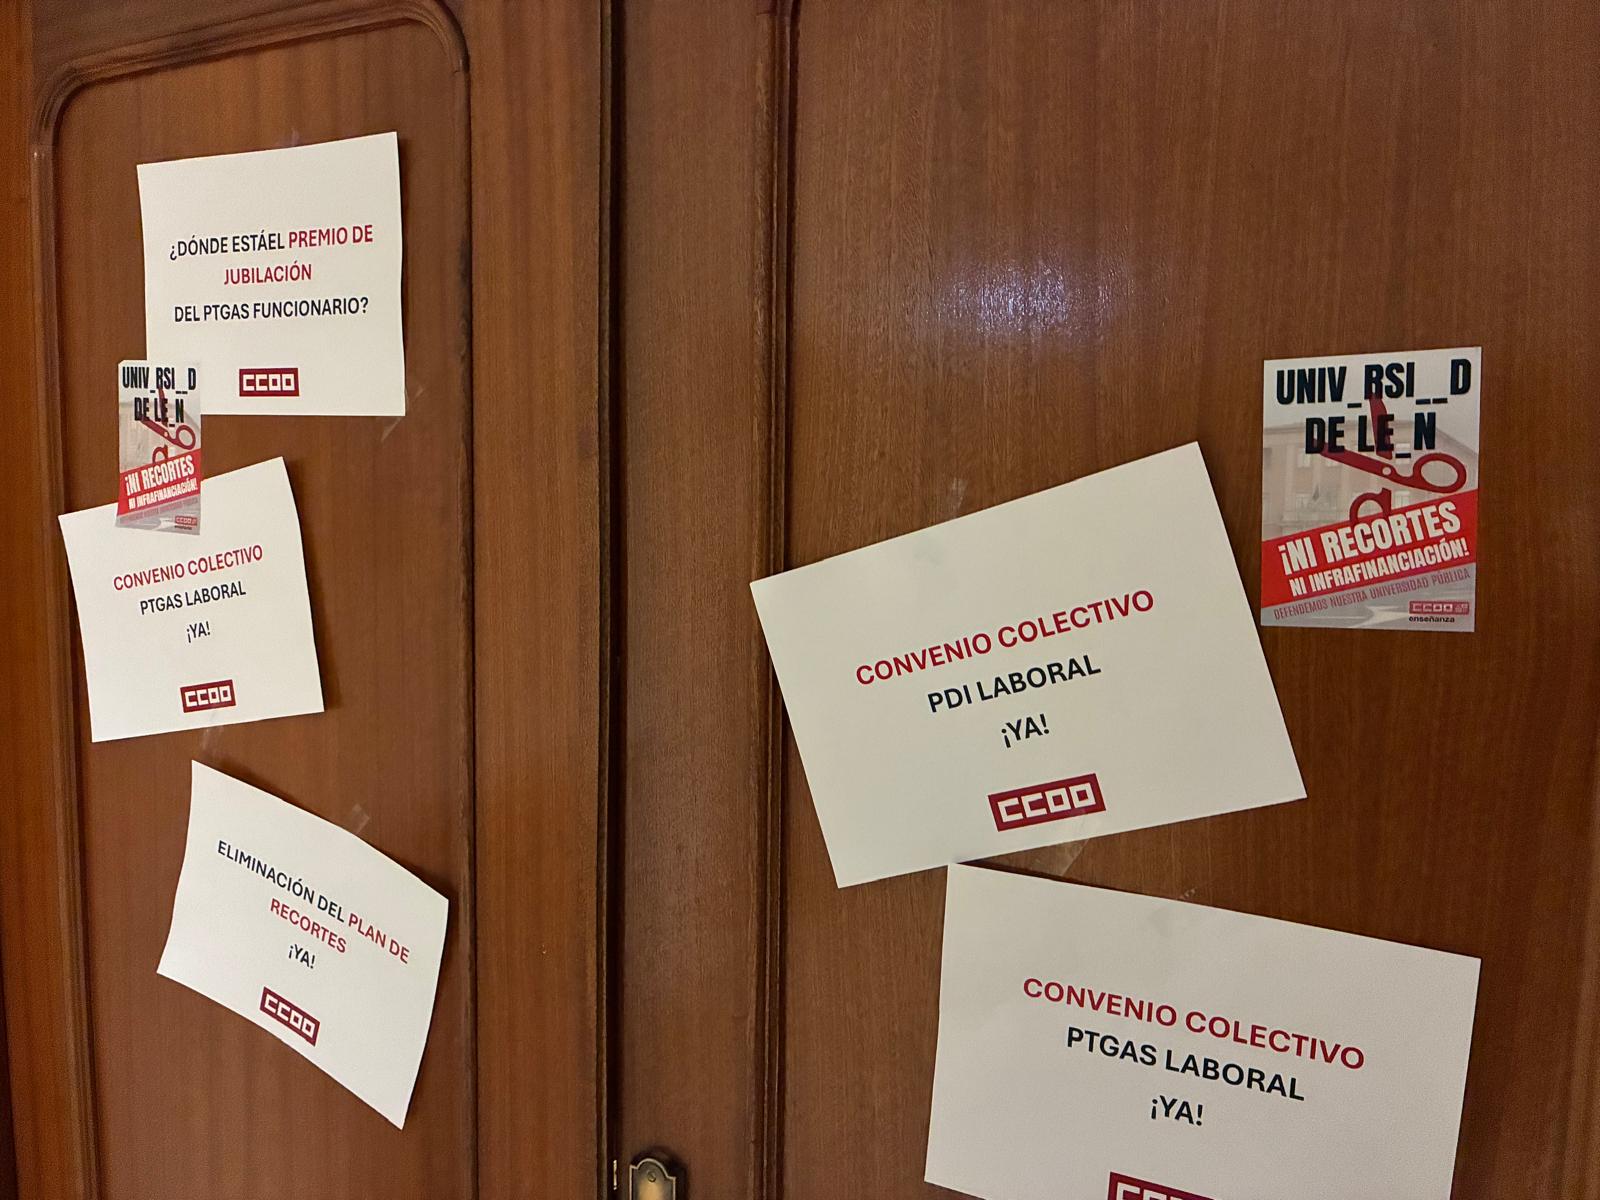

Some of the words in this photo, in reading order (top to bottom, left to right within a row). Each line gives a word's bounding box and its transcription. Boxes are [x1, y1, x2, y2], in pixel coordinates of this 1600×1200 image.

[170, 235, 228, 260] ¿DÓNDE
[288, 227, 348, 248] PREMIO
[352, 225, 373, 243] DE
[224, 261, 312, 285] JUBILACIÓN
[175, 305, 200, 322] DEL
[203, 304, 249, 321] PTGAS
[253, 297, 369, 319] FUNCIONARIO?
[241, 373, 296, 392] CCOO
[134, 397, 150, 421] DE
[1305, 416, 1345, 454] DE
[124, 474, 141, 496] ¡NI
[143, 455, 195, 489] RECORTES
[128, 498, 136, 510] NI
[136, 479, 198, 508] INFRAFINANCIACIÓN!
[1277, 536, 1317, 576] ¡NI
[1320, 500, 1461, 563] RECORTES
[113, 563, 185, 591] CONVENIO
[188, 544, 263, 576] COLECTIVO
[1288, 576, 1307, 597] NI
[1308, 538, 1470, 593] INFRAFINANCIACIÓN!
[140, 593, 183, 615] PTGAS
[185, 580, 246, 607] LABORAL
[1273, 597, 1329, 620] DEFENDEMOS
[1330, 587, 1369, 609] NUESTRA
[1370, 577, 1430, 600] UNIVERSIDAD
[1431, 566, 1471, 587] PÚBLICA
[1411, 602, 1454, 613] CCOO
[187, 621, 211, 643] ¡YA!
[1408, 615, 1455, 623] enseñanza
[856, 633, 992, 685] CONVENIO
[997, 590, 1154, 648] COLECTIVO
[184, 685, 232, 708] CCOO
[927, 684, 973, 713] PDI
[976, 655, 1102, 701] LABORAL
[1001, 713, 1050, 748] ¡YA!
[996, 781, 1097, 823] CCOO
[217, 840, 314, 904] ELIMINACIÓN
[317, 895, 345, 923] DEL
[348, 912, 386, 948] PLAN
[389, 939, 410, 964] DE
[270, 898, 346, 954] RECORTES
[288, 944, 316, 969] ¡YA!
[264, 992, 316, 1040] CCOO
[1023, 978, 1177, 1027] CONVENIO
[1185, 1011, 1365, 1070] COLECTIVO
[1067, 1026, 1157, 1066] PTGAS
[1165, 1049, 1305, 1101] LABORAL
[1151, 1095, 1203, 1126] ¡YA!
